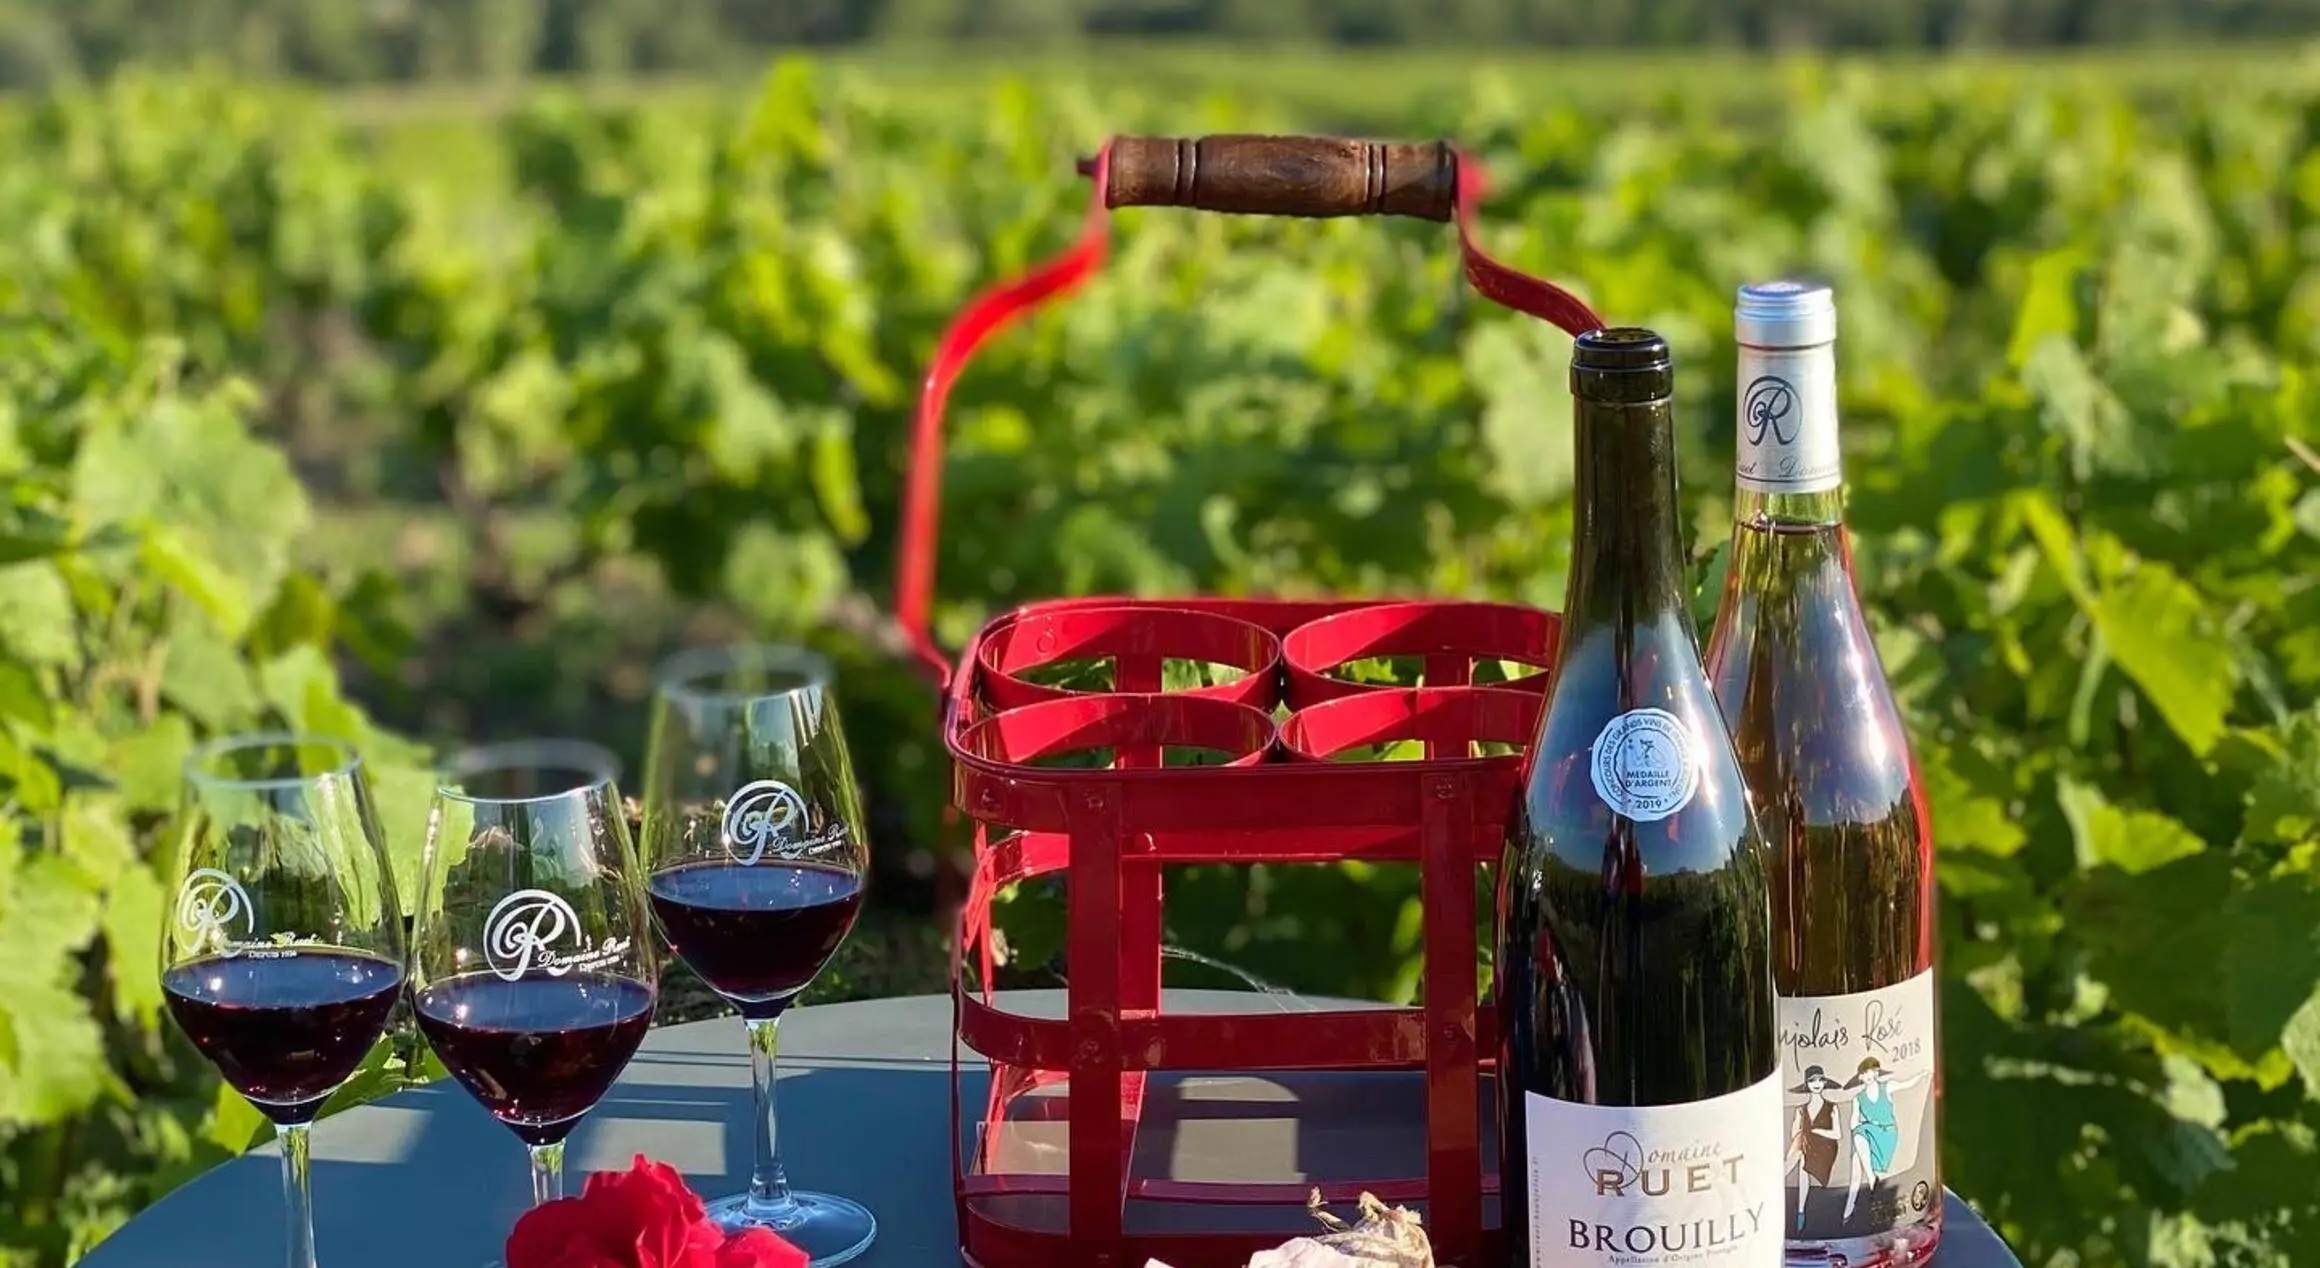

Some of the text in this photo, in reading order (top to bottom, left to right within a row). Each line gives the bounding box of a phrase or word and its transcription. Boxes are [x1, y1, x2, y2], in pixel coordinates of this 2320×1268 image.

[1625, 779, 1672, 788] D'ARGENT
[1636, 800, 1662, 809] 2019
[537, 950, 600, 968] Domaine
[1862, 1000, 1904, 1053] Rosé
[1892, 1038, 1922, 1063] 2018
[1596, 1154, 1745, 1197] RUET
[1568, 1202, 1765, 1254] BROUILLY
